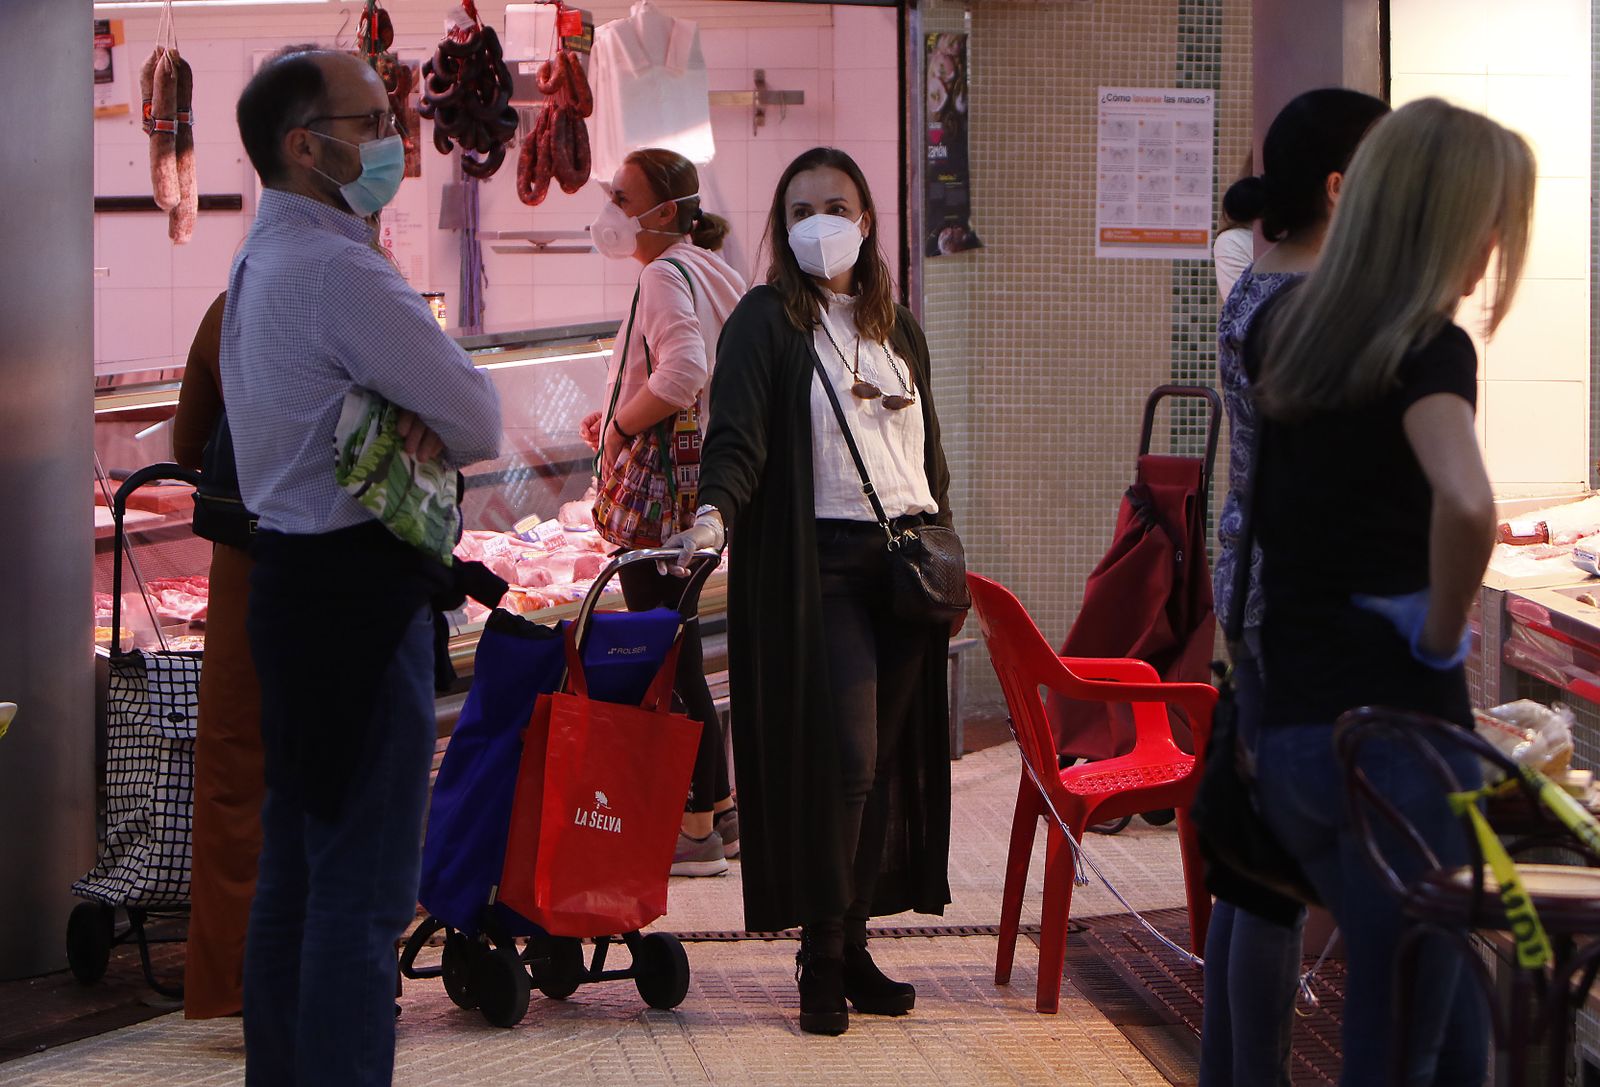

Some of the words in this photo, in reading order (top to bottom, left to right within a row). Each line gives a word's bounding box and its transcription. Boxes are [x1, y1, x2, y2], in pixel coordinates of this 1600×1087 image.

[1164, 94, 1176, 103] las
[1177, 95, 1210, 104] manos?
[617, 646, 647, 655] ROLSER
[574, 807, 588, 826] LA
[589, 810, 622, 834] SELVA
